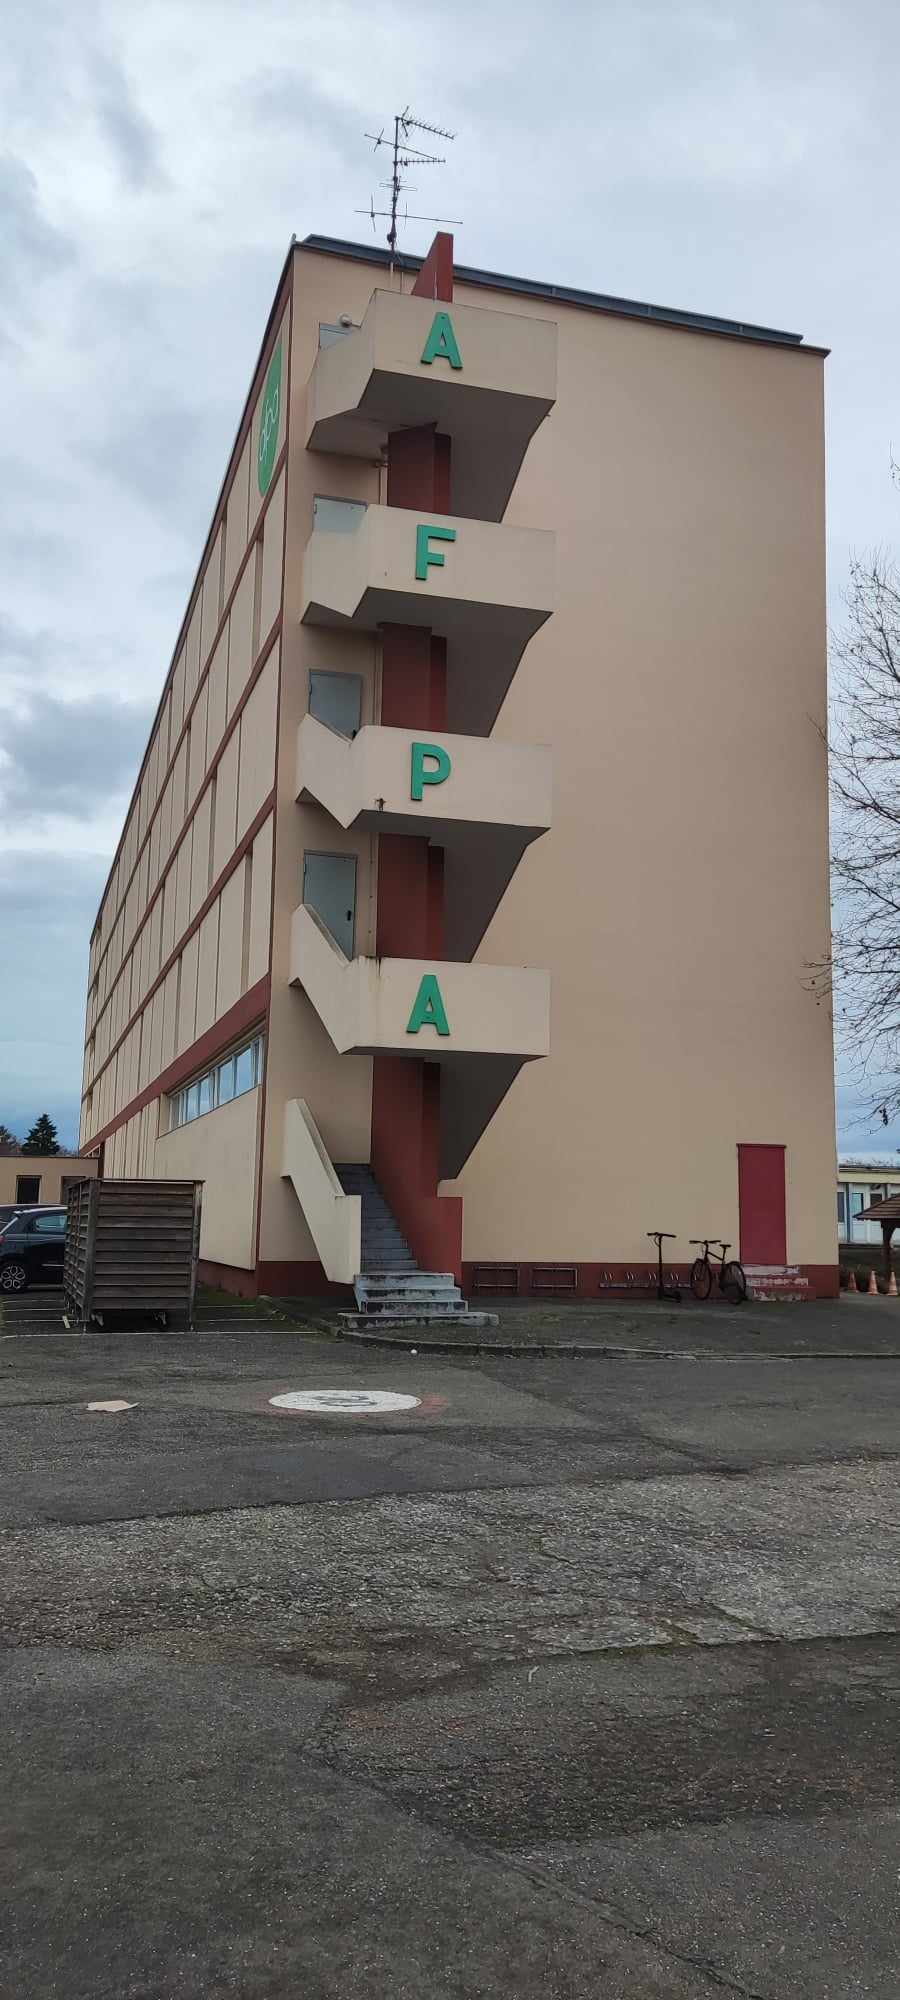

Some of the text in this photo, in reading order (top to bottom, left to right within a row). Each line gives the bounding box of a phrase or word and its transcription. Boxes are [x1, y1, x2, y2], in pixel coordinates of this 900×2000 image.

[421, 312, 462, 369] A
[414, 524, 457, 581] F
[410, 742, 452, 801] P
[407, 974, 450, 1036] A
